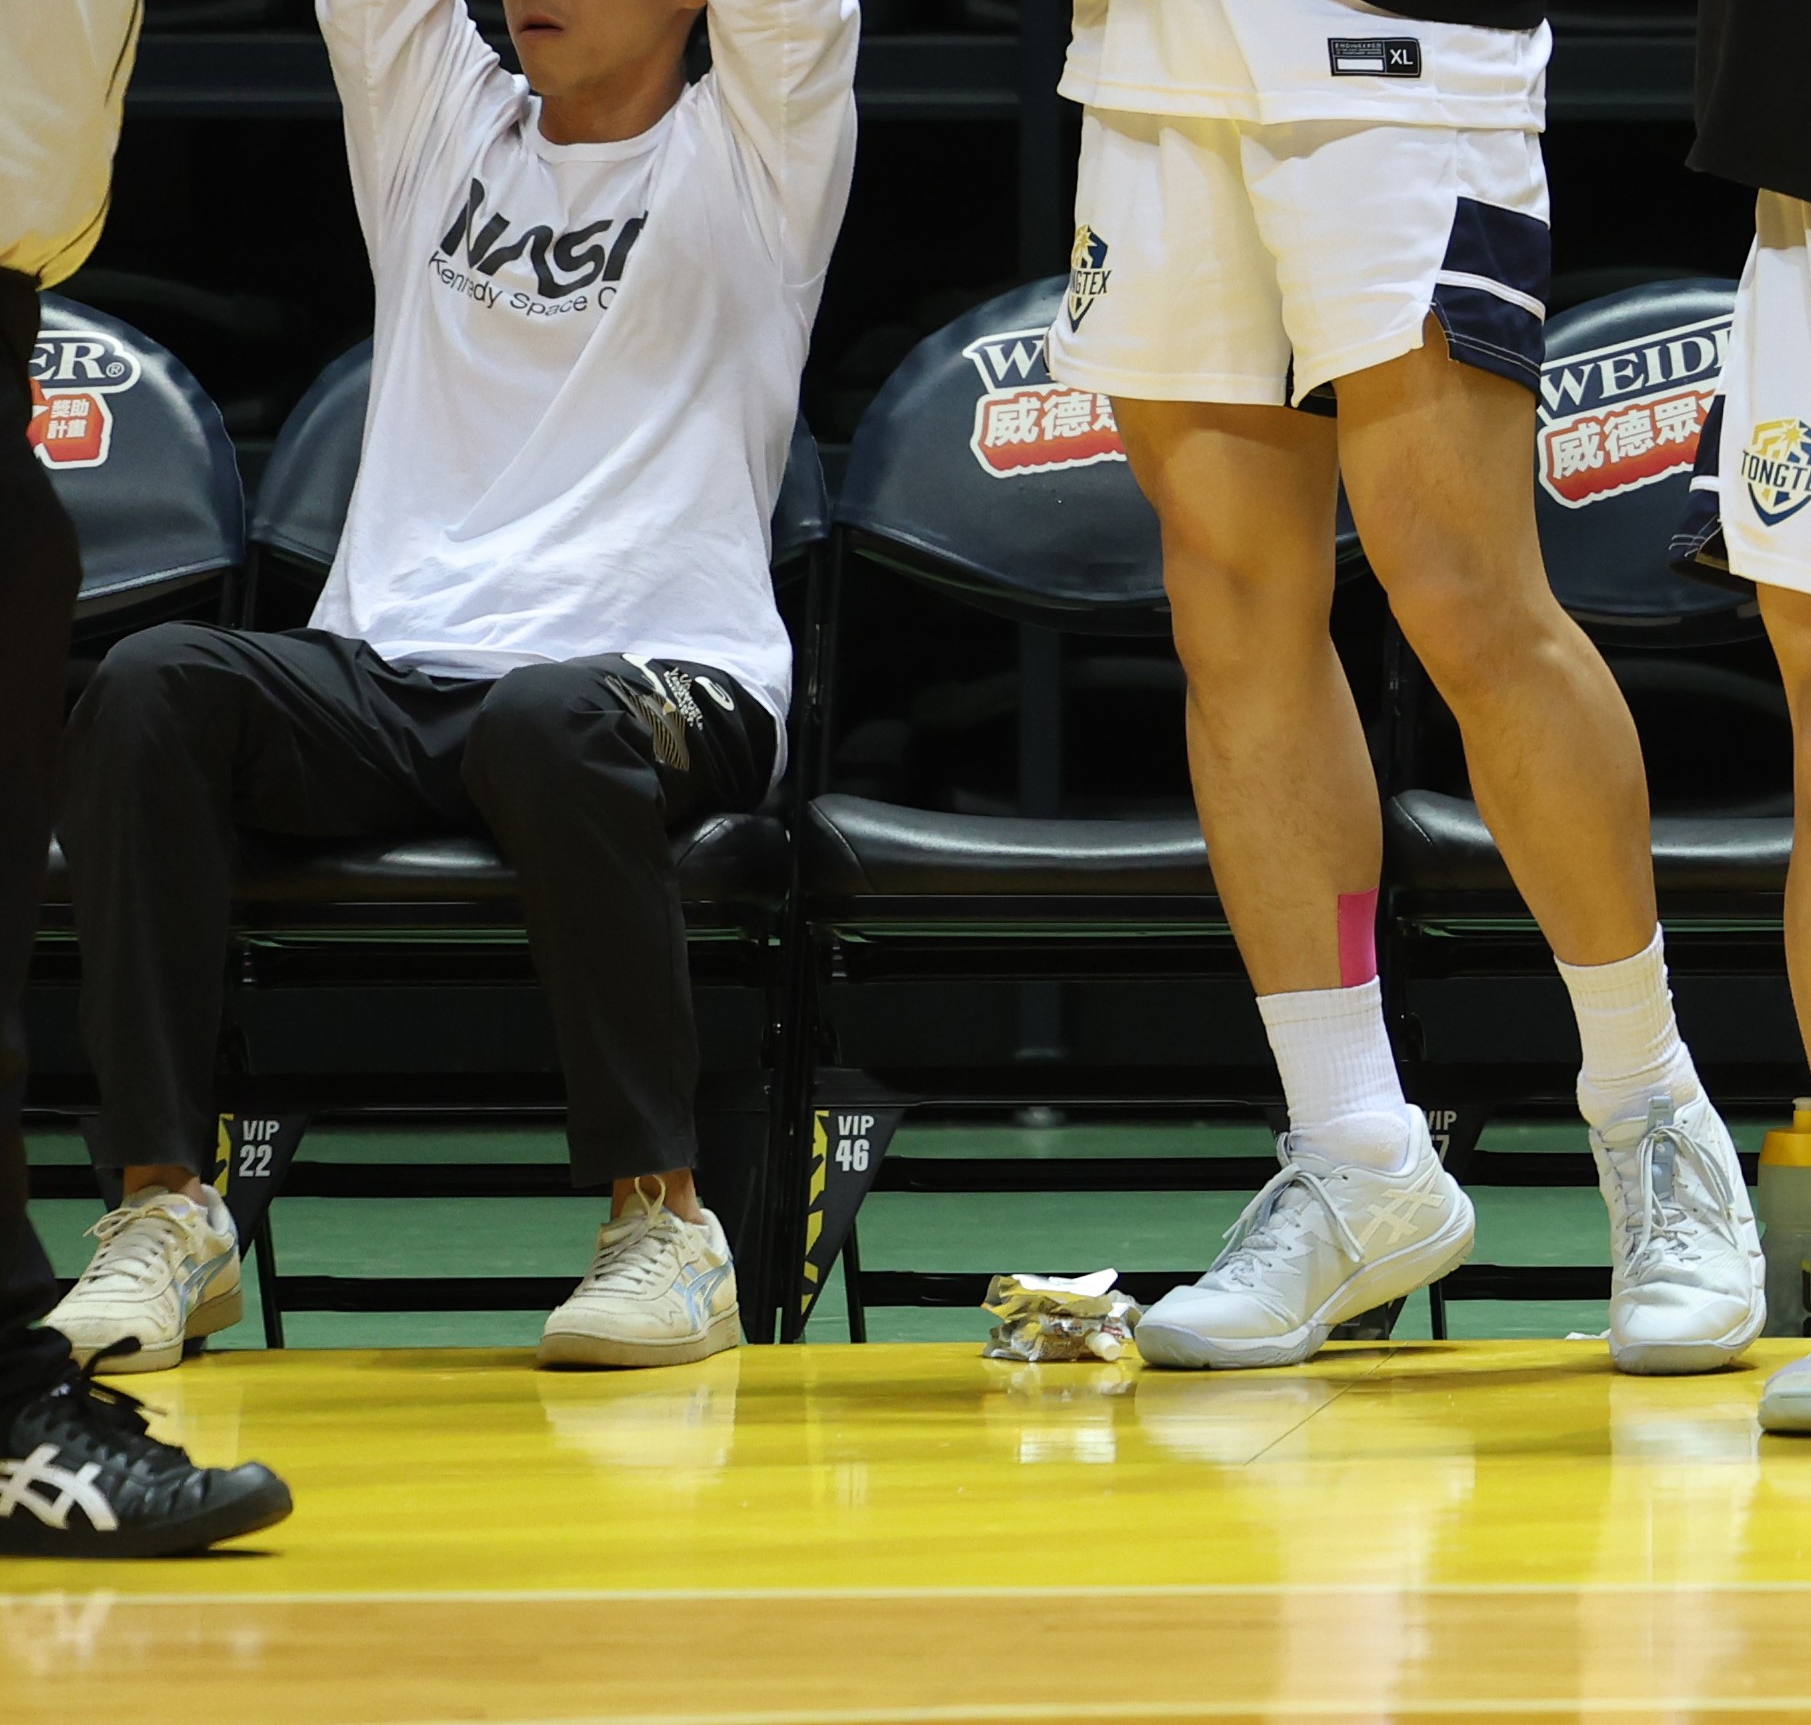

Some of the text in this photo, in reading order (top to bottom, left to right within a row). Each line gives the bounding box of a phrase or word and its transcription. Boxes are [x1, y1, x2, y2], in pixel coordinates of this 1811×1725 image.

[1389, 48, 1414, 66] XL
[509, 291, 589, 318] Space
[242, 1119, 280, 1142] VIP
[837, 1114, 875, 1136] VIP
[238, 1143, 274, 1178] 22
[835, 1138, 871, 1172] 46
[1431, 1133, 1451, 1165] 7
